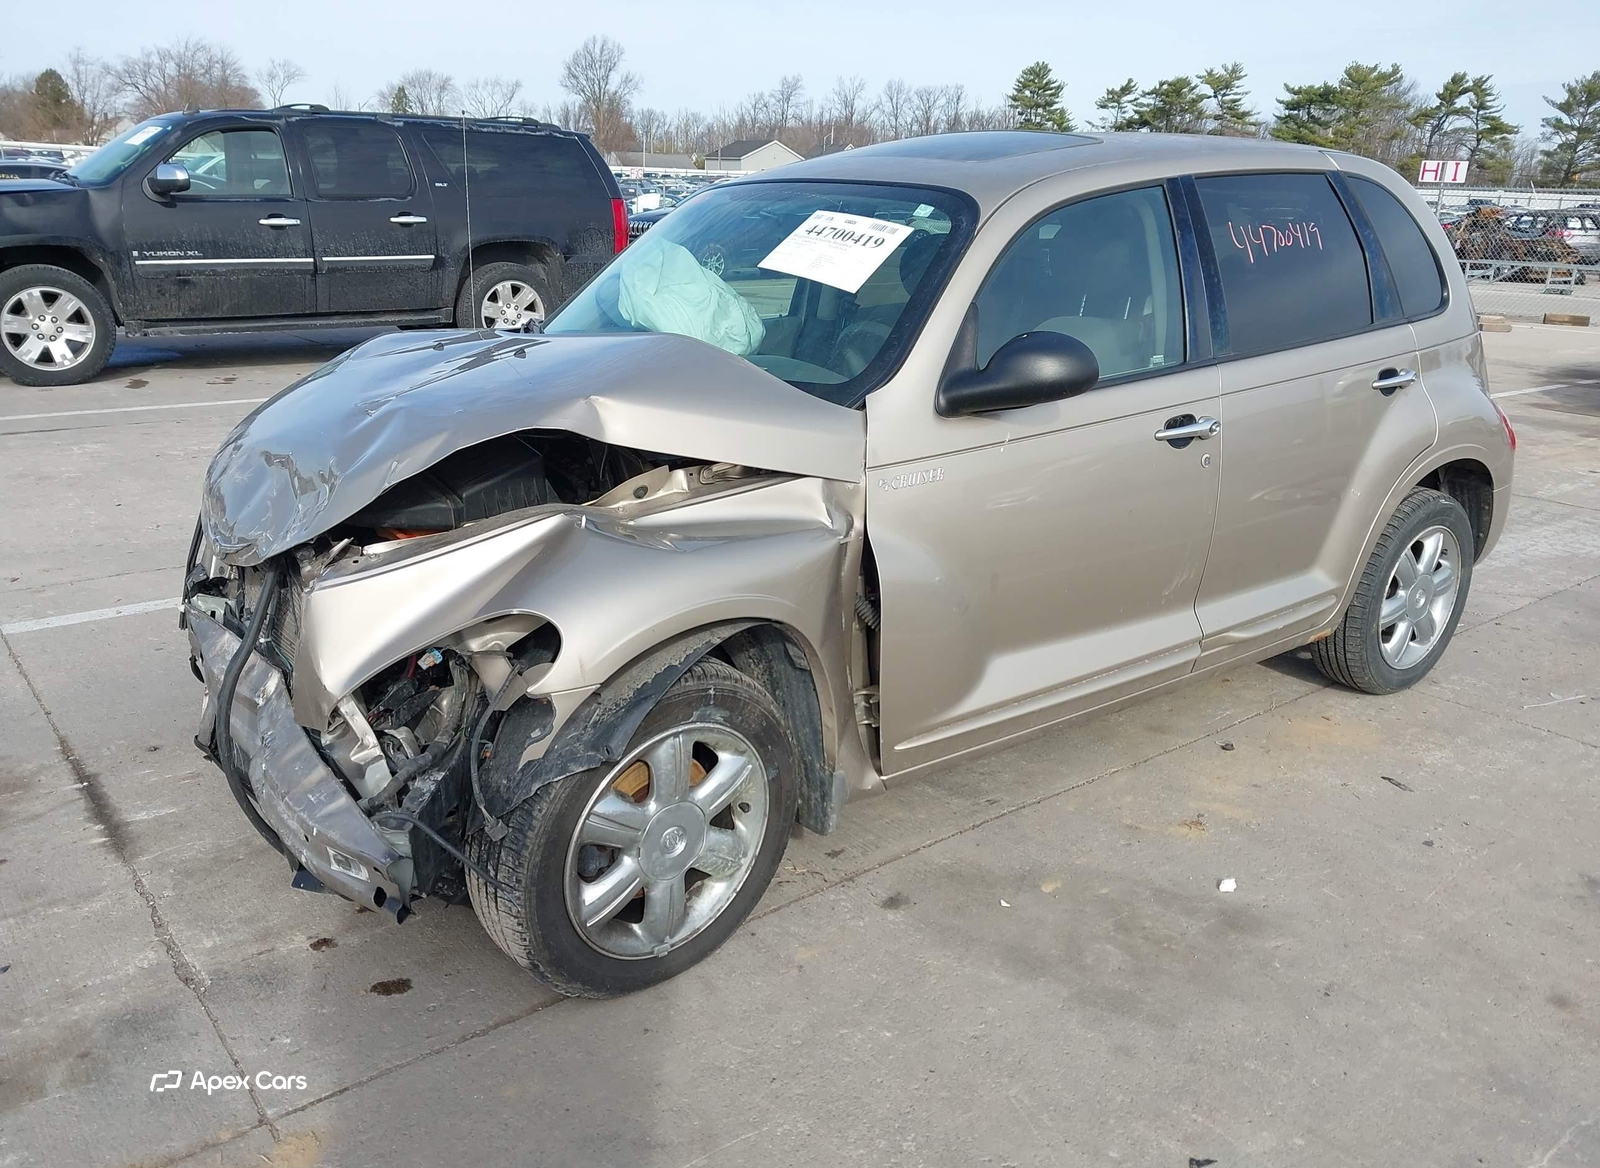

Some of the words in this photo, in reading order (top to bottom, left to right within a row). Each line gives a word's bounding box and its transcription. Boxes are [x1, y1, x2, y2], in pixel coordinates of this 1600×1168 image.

[805, 224, 886, 249] 44700419
[1228, 221, 1323, 264] 44700419
[891, 467, 944, 490] CRUISER
